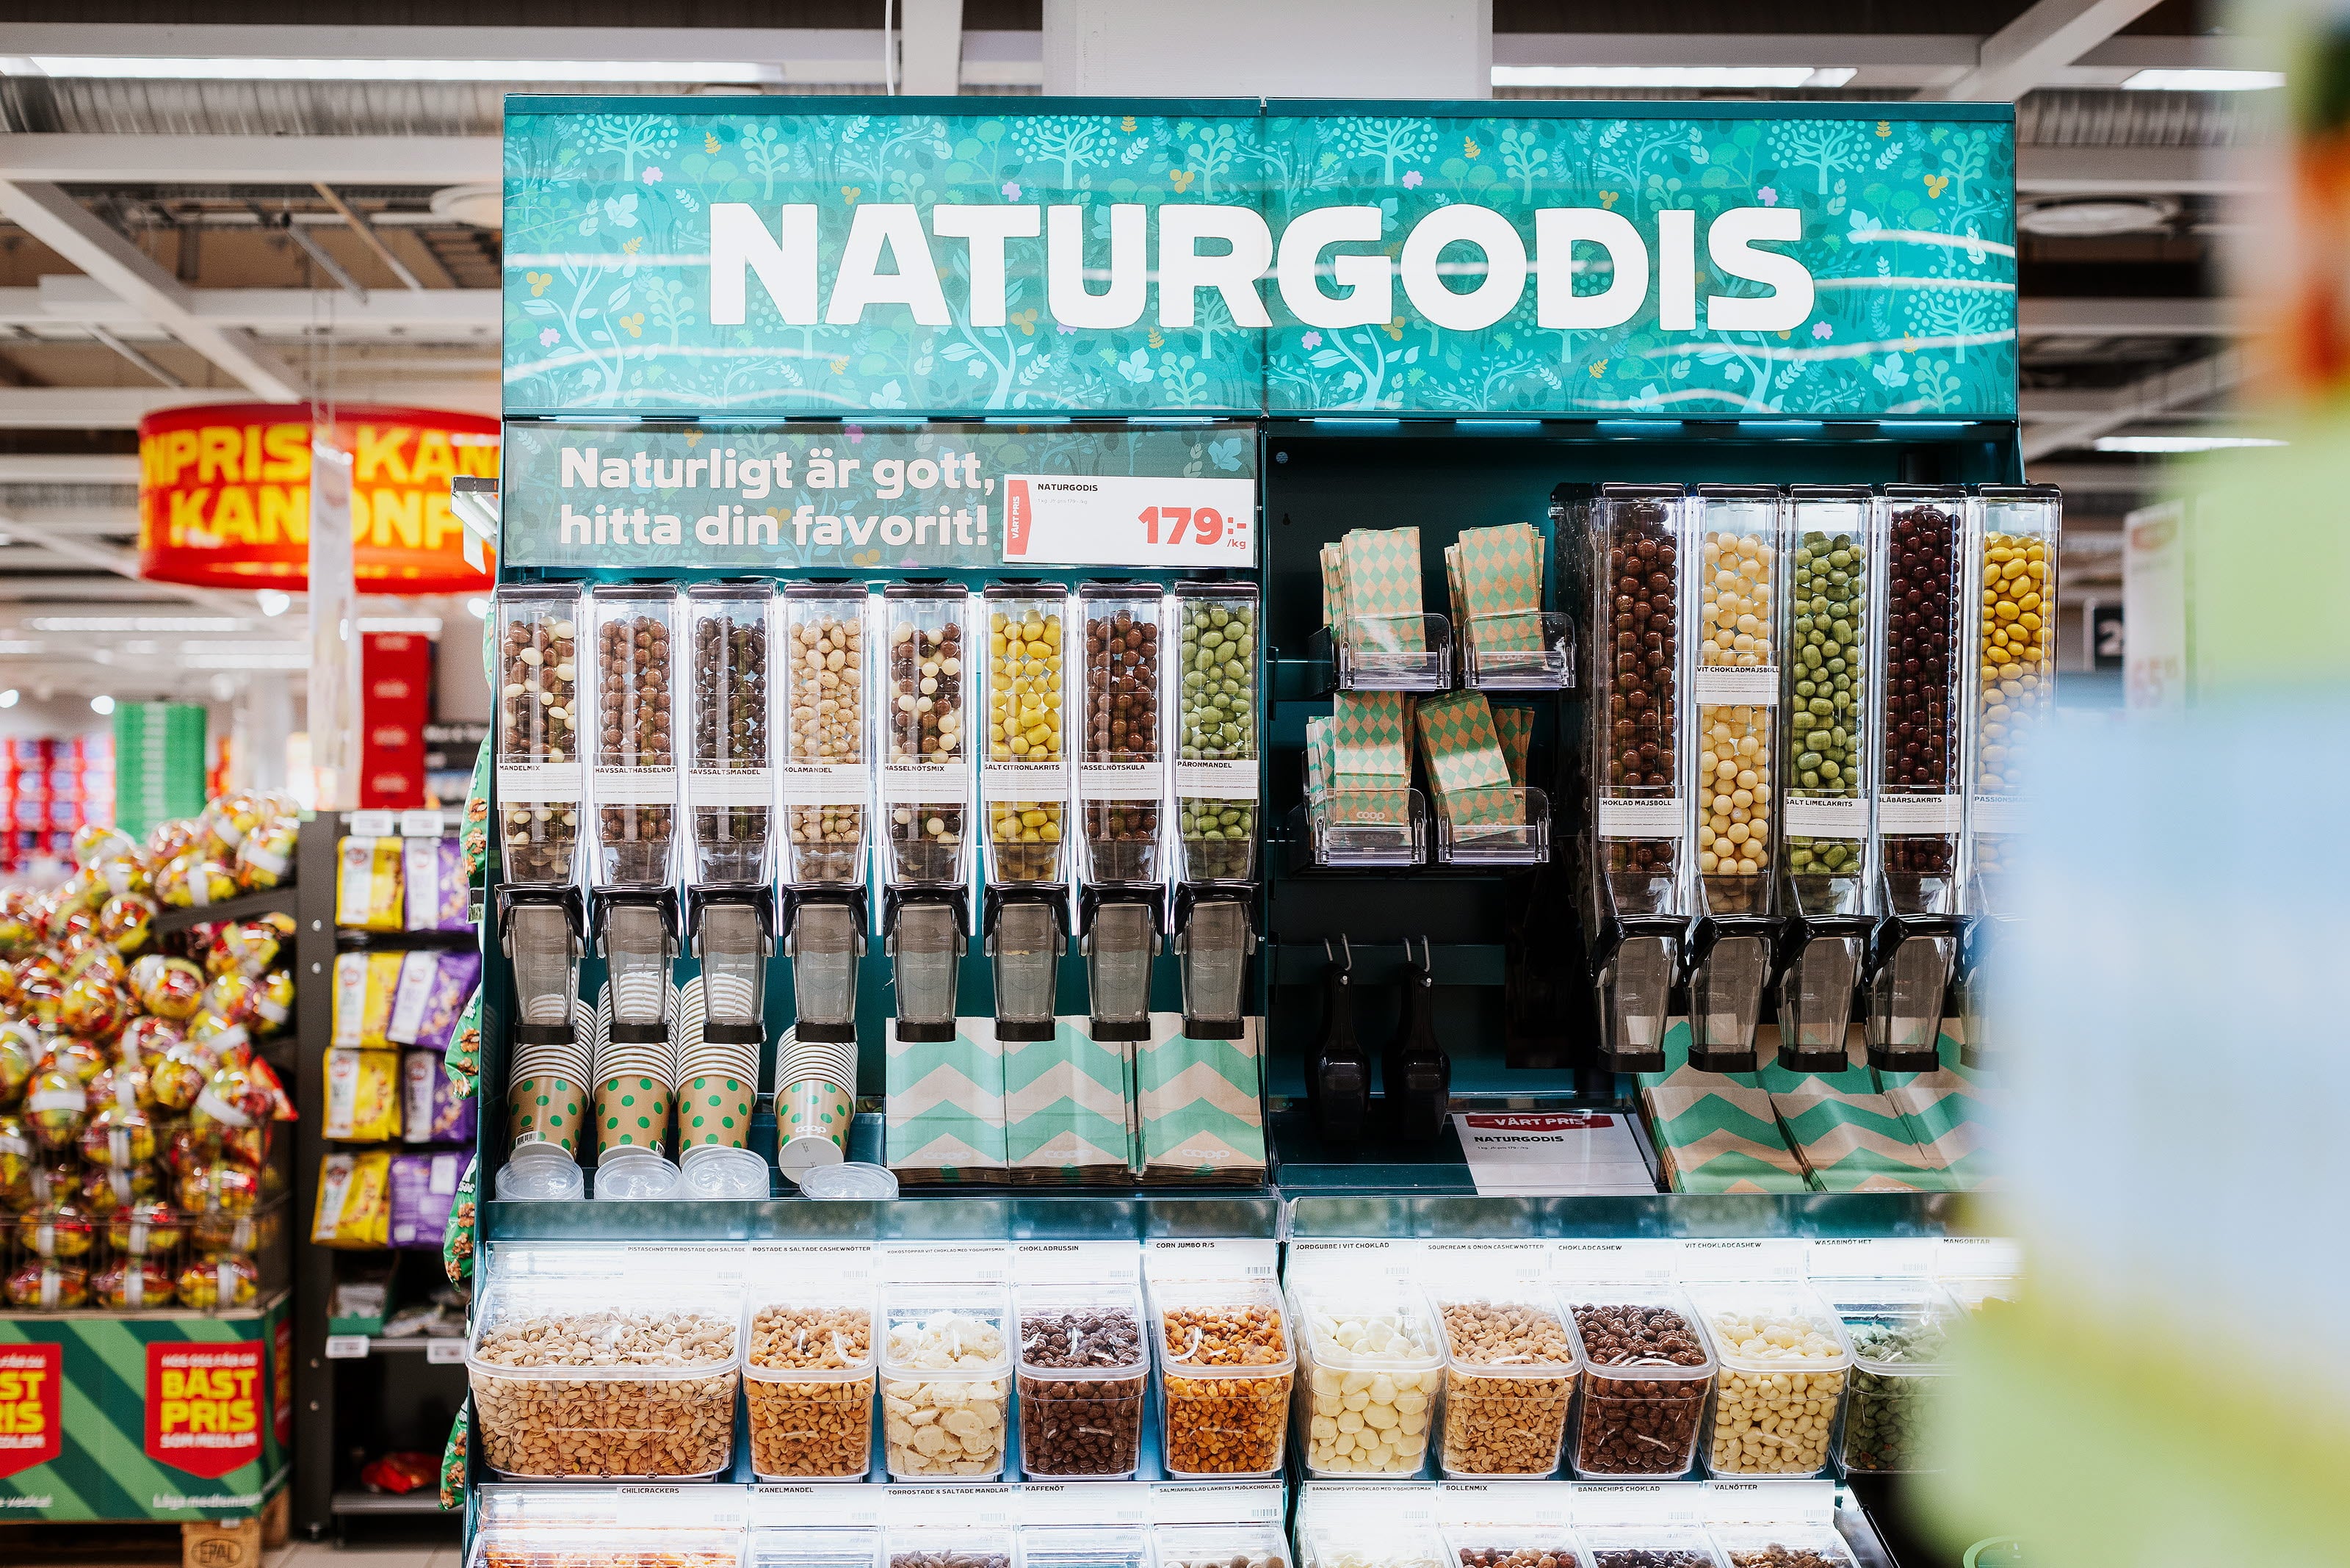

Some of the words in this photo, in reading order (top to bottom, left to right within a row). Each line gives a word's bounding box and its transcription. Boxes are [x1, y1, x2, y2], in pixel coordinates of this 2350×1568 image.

[709, 203, 1815, 331] NATURGODIS
[356, 424, 500, 486] KAN
[560, 447, 792, 499] Naturligt
[806, 448, 861, 488] är
[872, 451, 994, 499] gott,
[1038, 483, 1098, 491] NATURGODIS
[1011, 496, 1020, 511] PRIS
[170, 485, 498, 552] KANNP
[560, 504, 682, 545] hitta
[695, 504, 779, 545] din
[792, 504, 988, 545] favorit!
[1011, 511, 1020, 539] VÅRT
[1138, 506, 1246, 545] 179:-
[1227, 539, 1246, 549] /kg
[1879, 795, 1942, 803] BLÅBÄRSLAKRITS
[1356, 811, 1385, 821] coop
[795, 1125, 827, 1134] coop
[1494, 1116, 1541, 1126] VÅRT
[1544, 1117, 1586, 1126] PRIS
[1182, 1149, 1230, 1160] coop
[160, 1398, 256, 1432] PRIS
